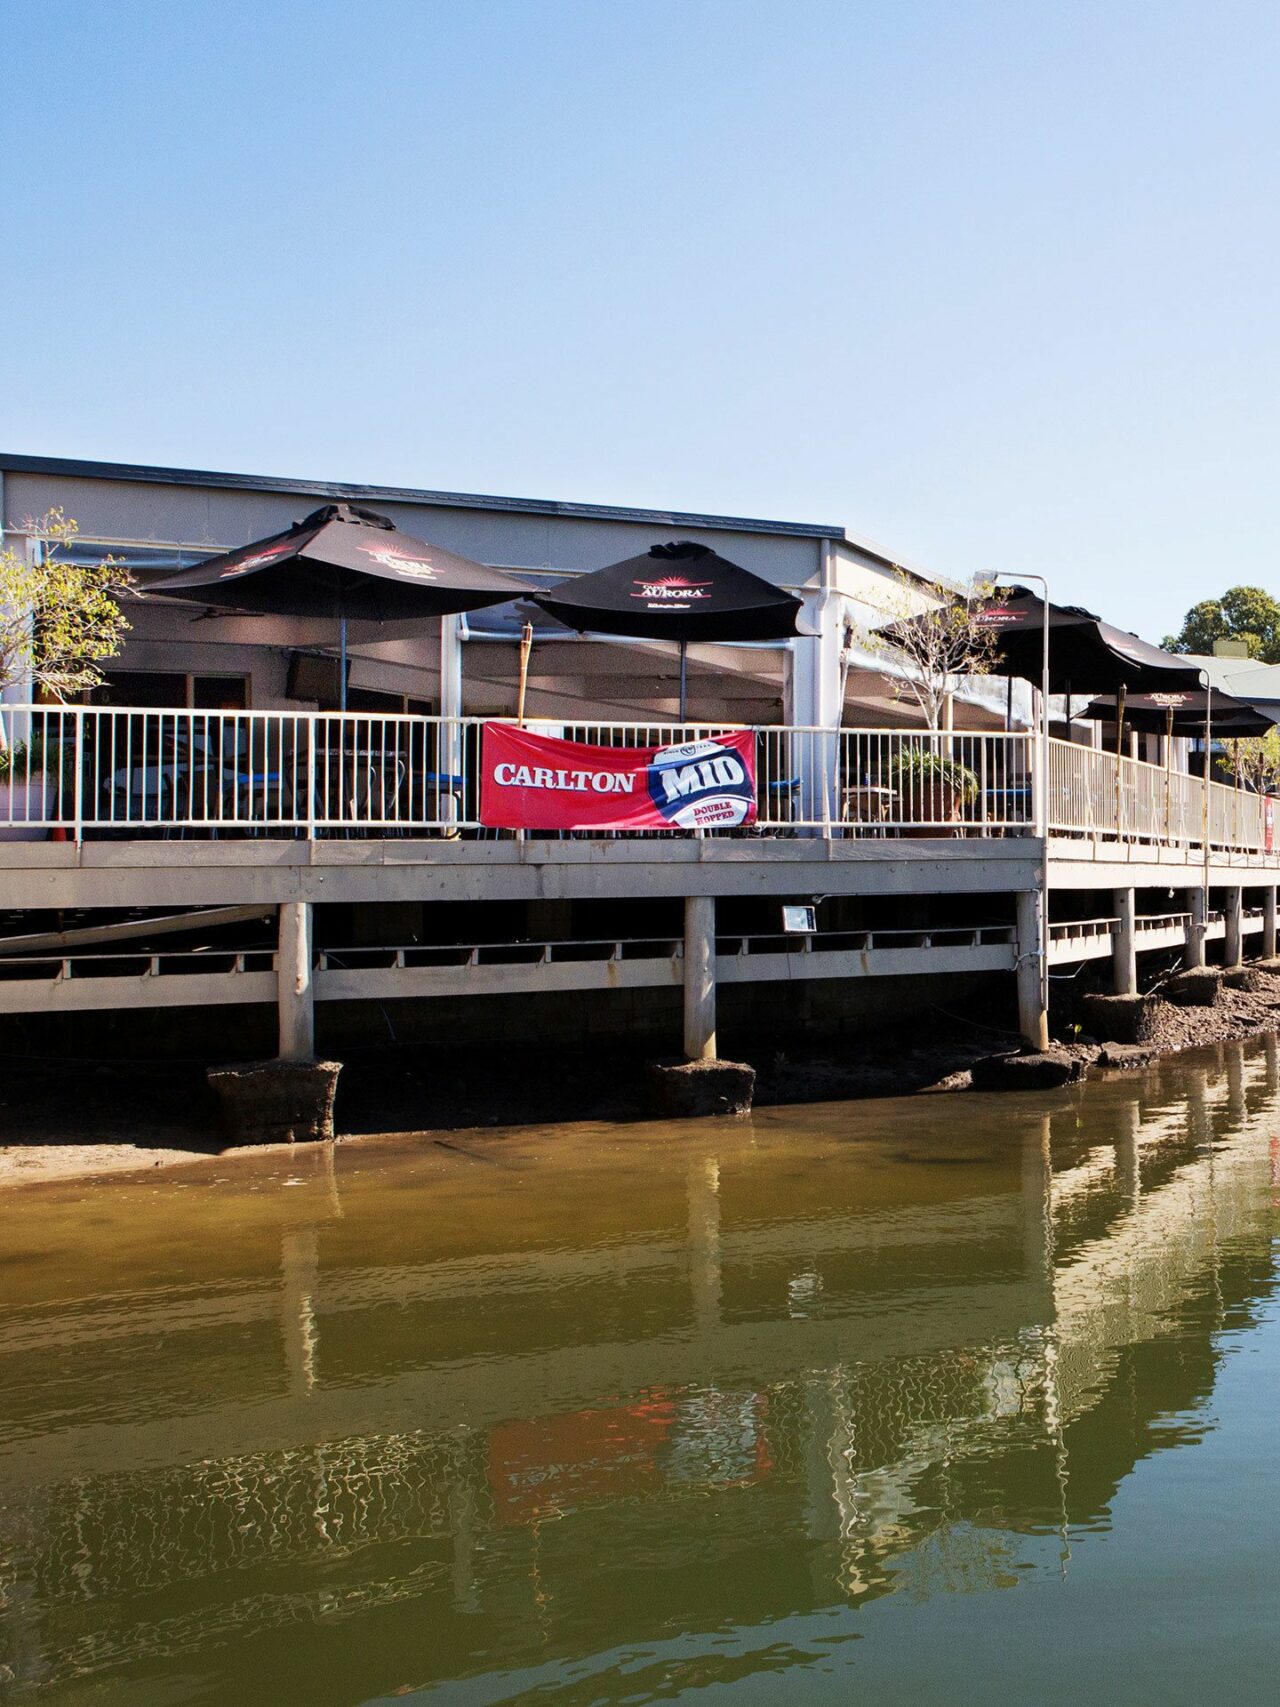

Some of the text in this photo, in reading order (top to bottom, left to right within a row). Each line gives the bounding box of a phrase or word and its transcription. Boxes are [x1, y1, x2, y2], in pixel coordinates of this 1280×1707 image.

[640, 587, 703, 598] AURORA
[493, 762, 637, 794] CARLTON
[659, 755, 745, 804] MID
[692, 801, 733, 817] DOUBLE
[694, 810, 735, 826] HOPPED
